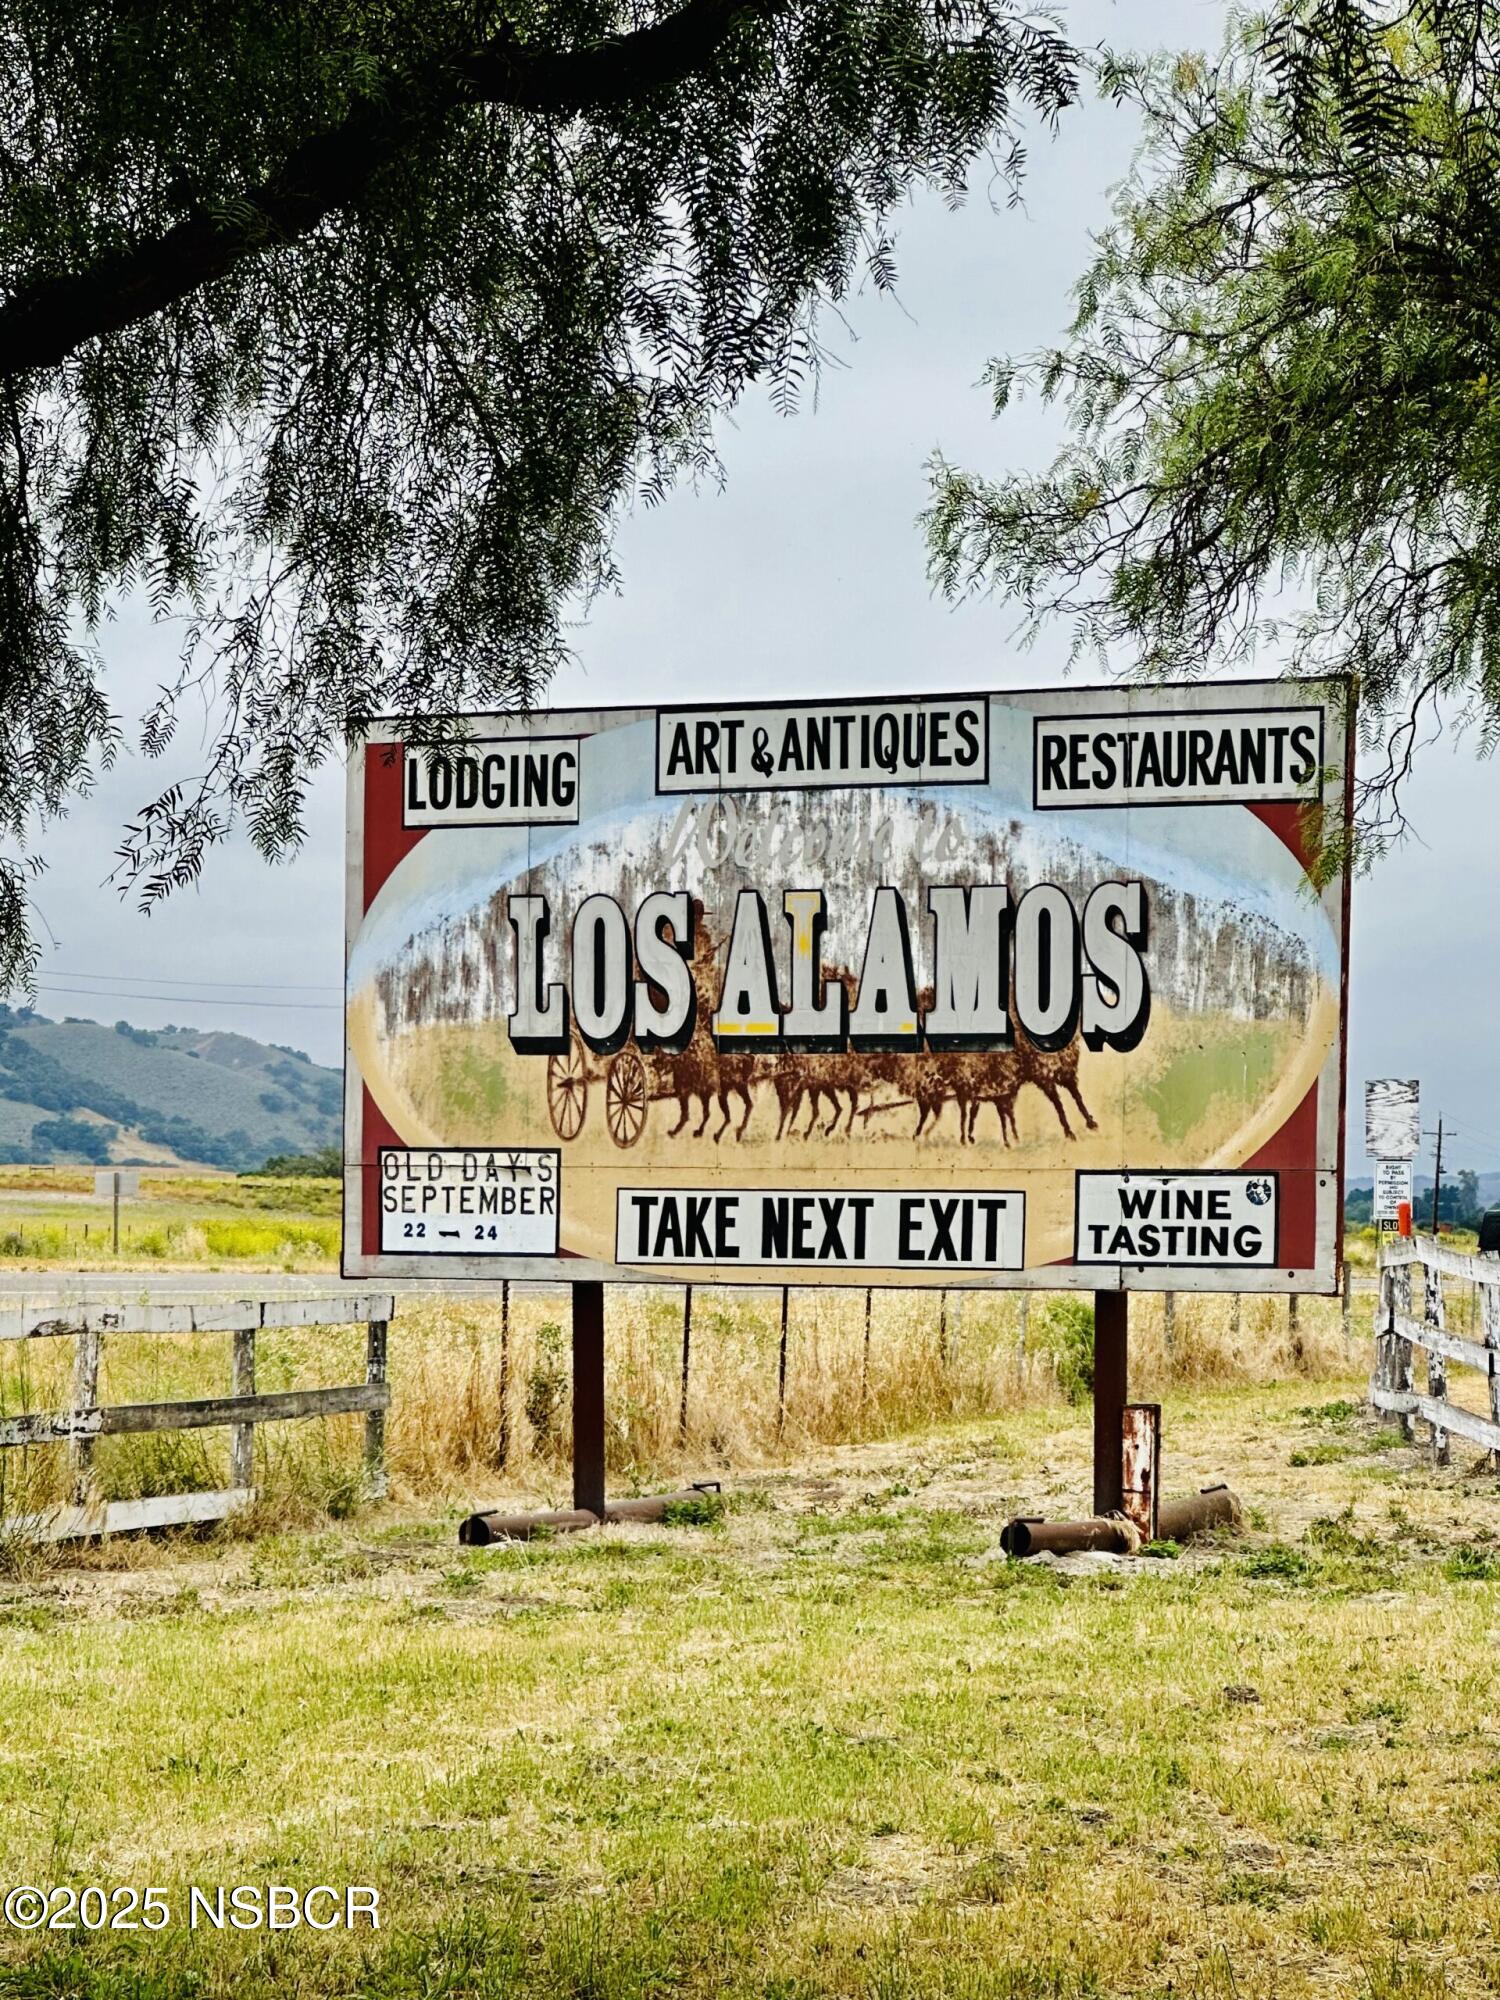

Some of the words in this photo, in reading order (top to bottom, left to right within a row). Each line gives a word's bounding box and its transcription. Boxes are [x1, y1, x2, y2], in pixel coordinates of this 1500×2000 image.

[666, 720, 744, 775] ART
[778, 709, 979, 774] ANTIQUES
[1042, 725, 1318, 791] RESTAURANTS
[408, 751, 577, 810] LODGING
[662, 794, 895, 869] Welcome
[914, 809, 959, 864] to
[508, 890, 697, 1056] LOS
[713, 880, 1152, 1054] ALAMOS
[384, 1152, 443, 1183] OLD
[462, 1153, 553, 1183] DAYS
[384, 1185, 555, 1216] SEPTEMBER
[1118, 1188, 1232, 1221] WINE
[404, 1223, 426, 1238] 22
[475, 1225, 498, 1240] 24
[631, 1196, 740, 1258] TAKE
[761, 1197, 874, 1260] NEXT
[898, 1198, 1007, 1262] EXIT
[1088, 1223, 1263, 1258] TASTING
[1383, 1221, 1398, 1230] SLO
